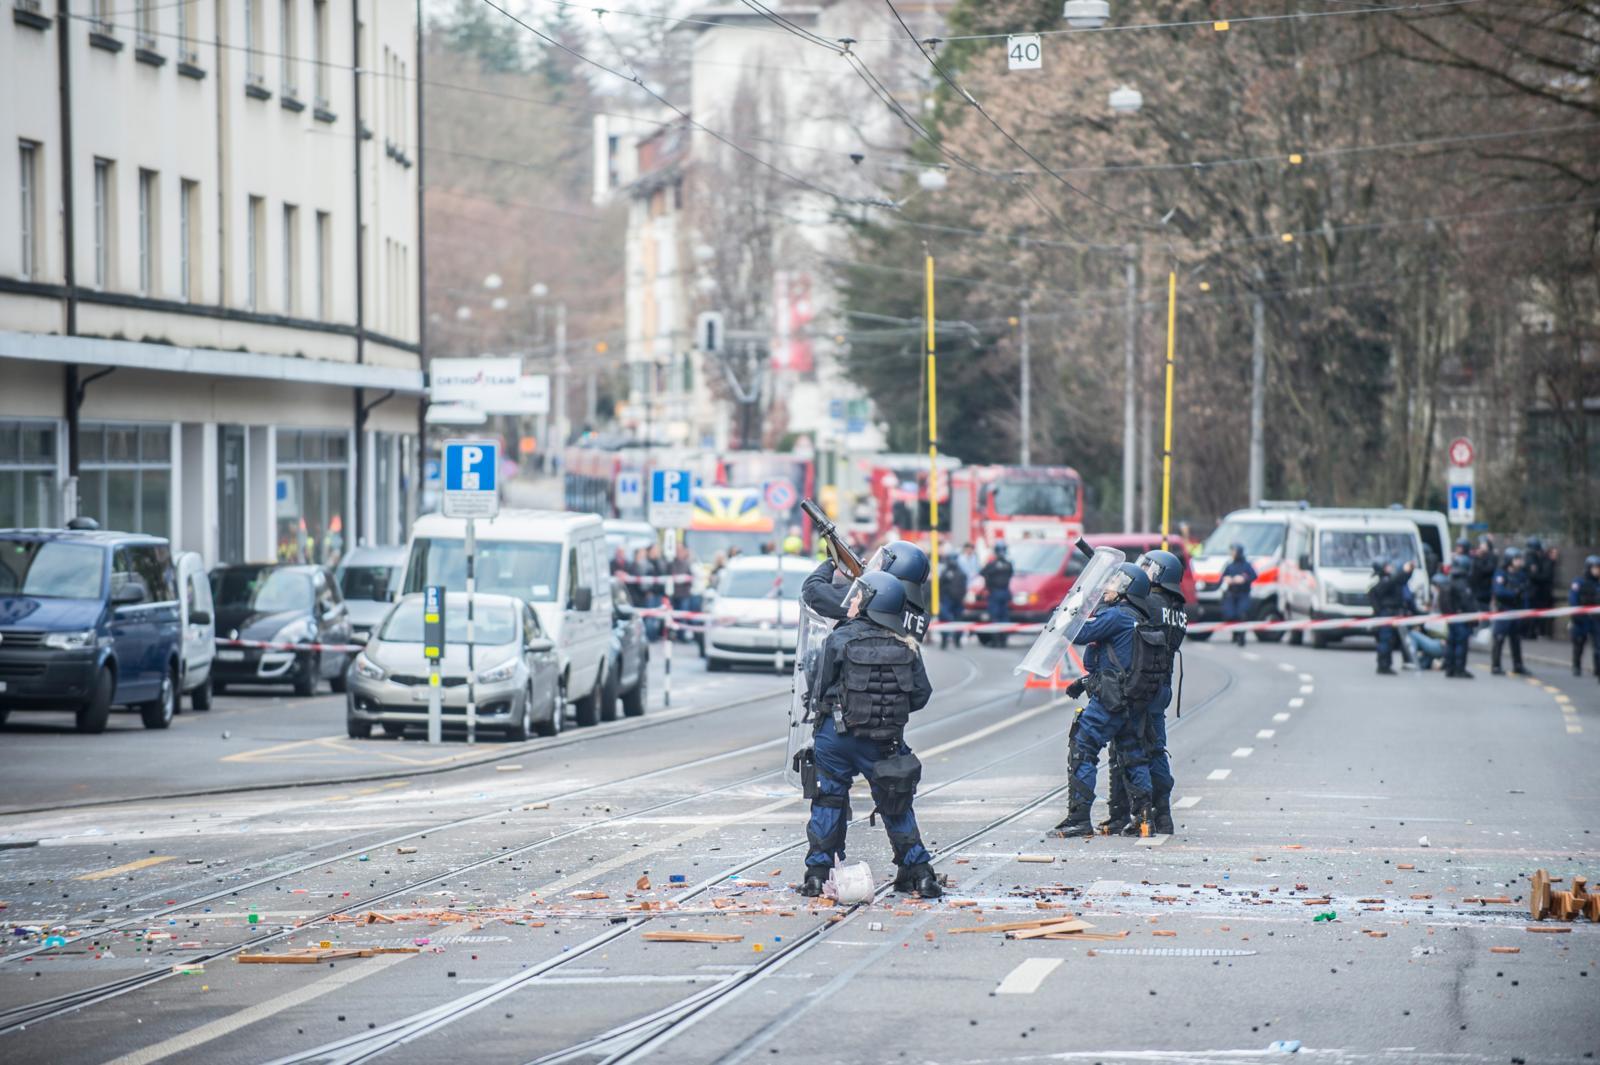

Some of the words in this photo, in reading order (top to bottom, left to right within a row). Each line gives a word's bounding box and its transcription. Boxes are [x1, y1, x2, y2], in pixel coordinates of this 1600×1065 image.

[1010, 43, 1040, 61] 40
[462, 446, 483, 472] P
[903, 611, 925, 634] ICE
[1162, 607, 1188, 628] POLICE
